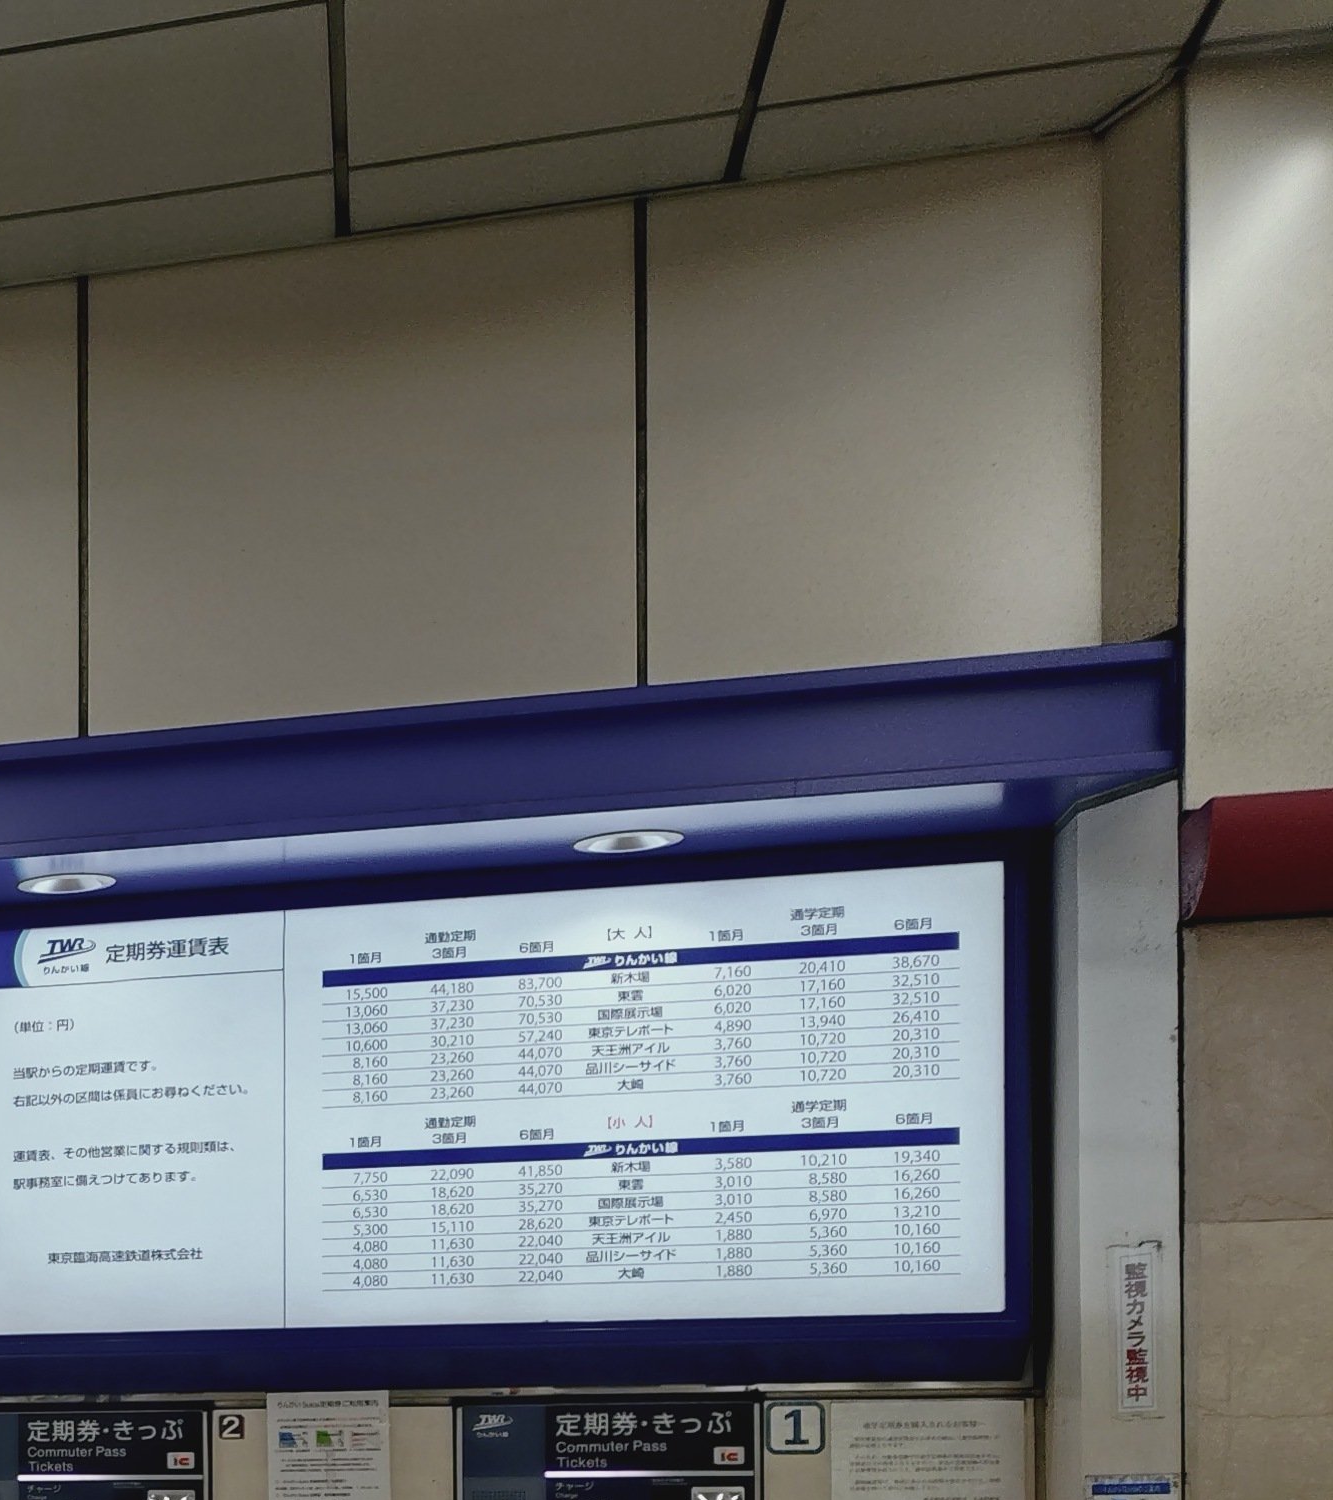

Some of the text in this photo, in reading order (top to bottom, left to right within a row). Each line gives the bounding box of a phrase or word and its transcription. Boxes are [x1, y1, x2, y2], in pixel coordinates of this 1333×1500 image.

[424, 929, 476, 944] 通勤定期
[790, 905, 845, 920] 通学定期
[41, 937, 91, 960] TWR
[106, 936, 229, 963] 定期券運賃表
[349, 916, 933, 965] 1箇月 3箇月 6箇月 1箇月 3箇月 6箇月
[345, 955, 940, 1000] 15,500 44,180 83,700 新木場 7,160 20,410 38,670
[345, 973, 940, 1017] 13,060 37,230 70,530 東雲 6,020 17,160 32,510
[345, 991, 940, 1034] 13,060 37,230 70,530 国際展示場 6,020 17,160 32,510
[345, 1009, 940, 1052] 10,600 30,210 57,240 東京テレポート 4,890 13,940 26,410
[353, 1027, 940, 1069] 8,160 23,260 44,070 天王洲アイル 3,760 10,720 20,310
[13, 1060, 157, 1079] 当駅からの定期運賃です。
[13, 1083, 249, 1107] 右記以外の区間は係員にお尋ねください。
[353, 1064, 940, 1103] 8,160 23,260 44,070 大崎 3,760 10,720 20,310
[13, 1140, 235, 1163] 運賃表、その他営業に関する規則類は、
[13, 1171, 196, 1190] 駅事務室に備えつけてあります。
[48, 1247, 203, 1264] 東京臨海高速鉄道株式会社
[1124, 1261, 1149, 1402] 監視カメラ監視中
[27, 1419, 183, 1442] 定期券・きっぷ
[222, 1416, 241, 1438] 2
[556, 1411, 732, 1437] 定期券・きっぷ
[783, 1409, 810, 1446] 1
[27, 1446, 126, 1458] Commuter Pass
[556, 1440, 667, 1454] Commuter Pass
[29, 1461, 73, 1472] Tickets
[556, 1457, 607, 1468] Tickets
